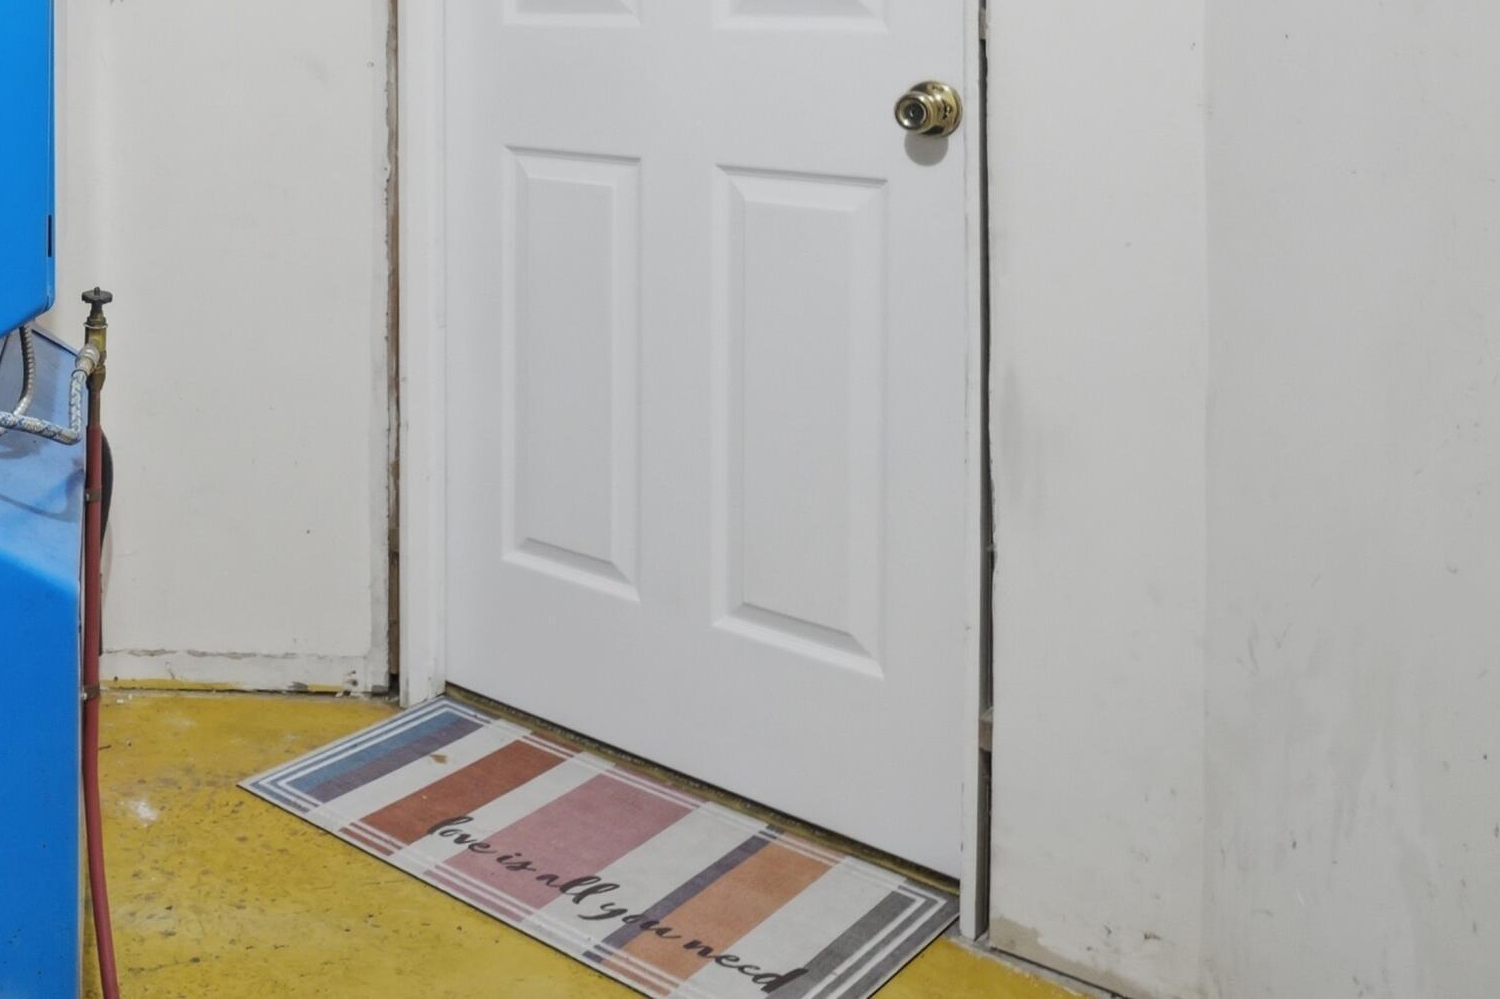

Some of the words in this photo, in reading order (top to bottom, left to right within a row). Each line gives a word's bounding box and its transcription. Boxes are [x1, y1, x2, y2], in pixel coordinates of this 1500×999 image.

[426, 815, 498, 855] love
[495, 851, 537, 873] is
[535, 874, 621, 905] all
[577, 901, 682, 940] you
[682, 938, 809, 994] need
